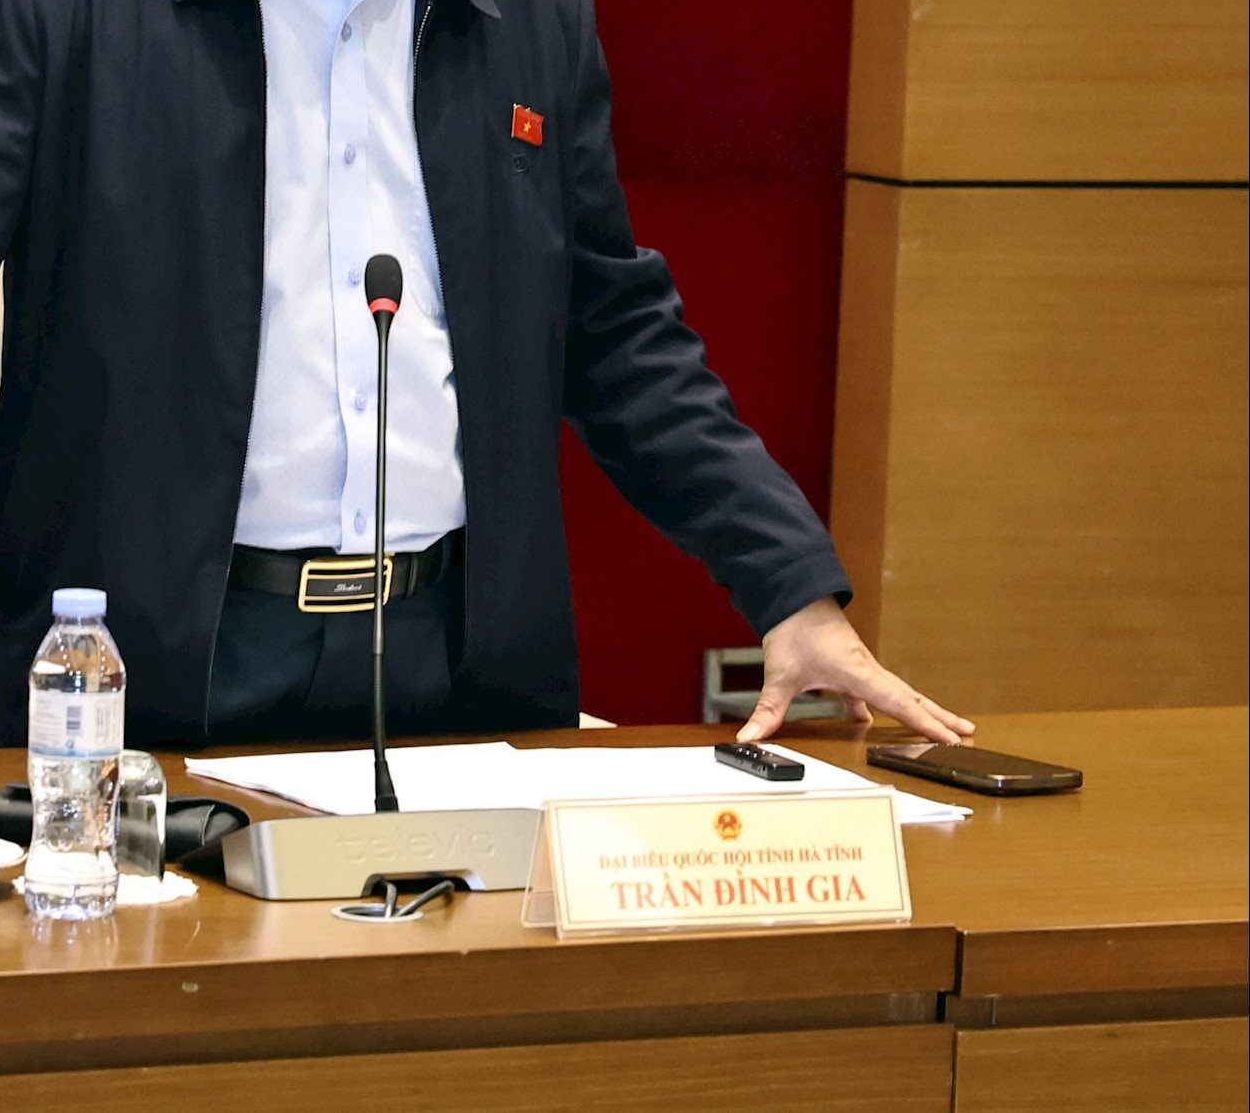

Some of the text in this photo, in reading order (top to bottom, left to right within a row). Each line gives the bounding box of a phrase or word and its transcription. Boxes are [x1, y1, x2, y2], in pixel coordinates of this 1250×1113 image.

[599, 853, 628, 872] ĐẠI
[632, 849, 669, 868] BIỂU
[673, 848, 719, 870] QUỐC
[723, 848, 752, 867] HỘI
[799, 844, 821, 862] HÀ
[825, 844, 863, 862] TĨNH
[610, 869, 868, 910] TRẦN ĐÌNH GIA
